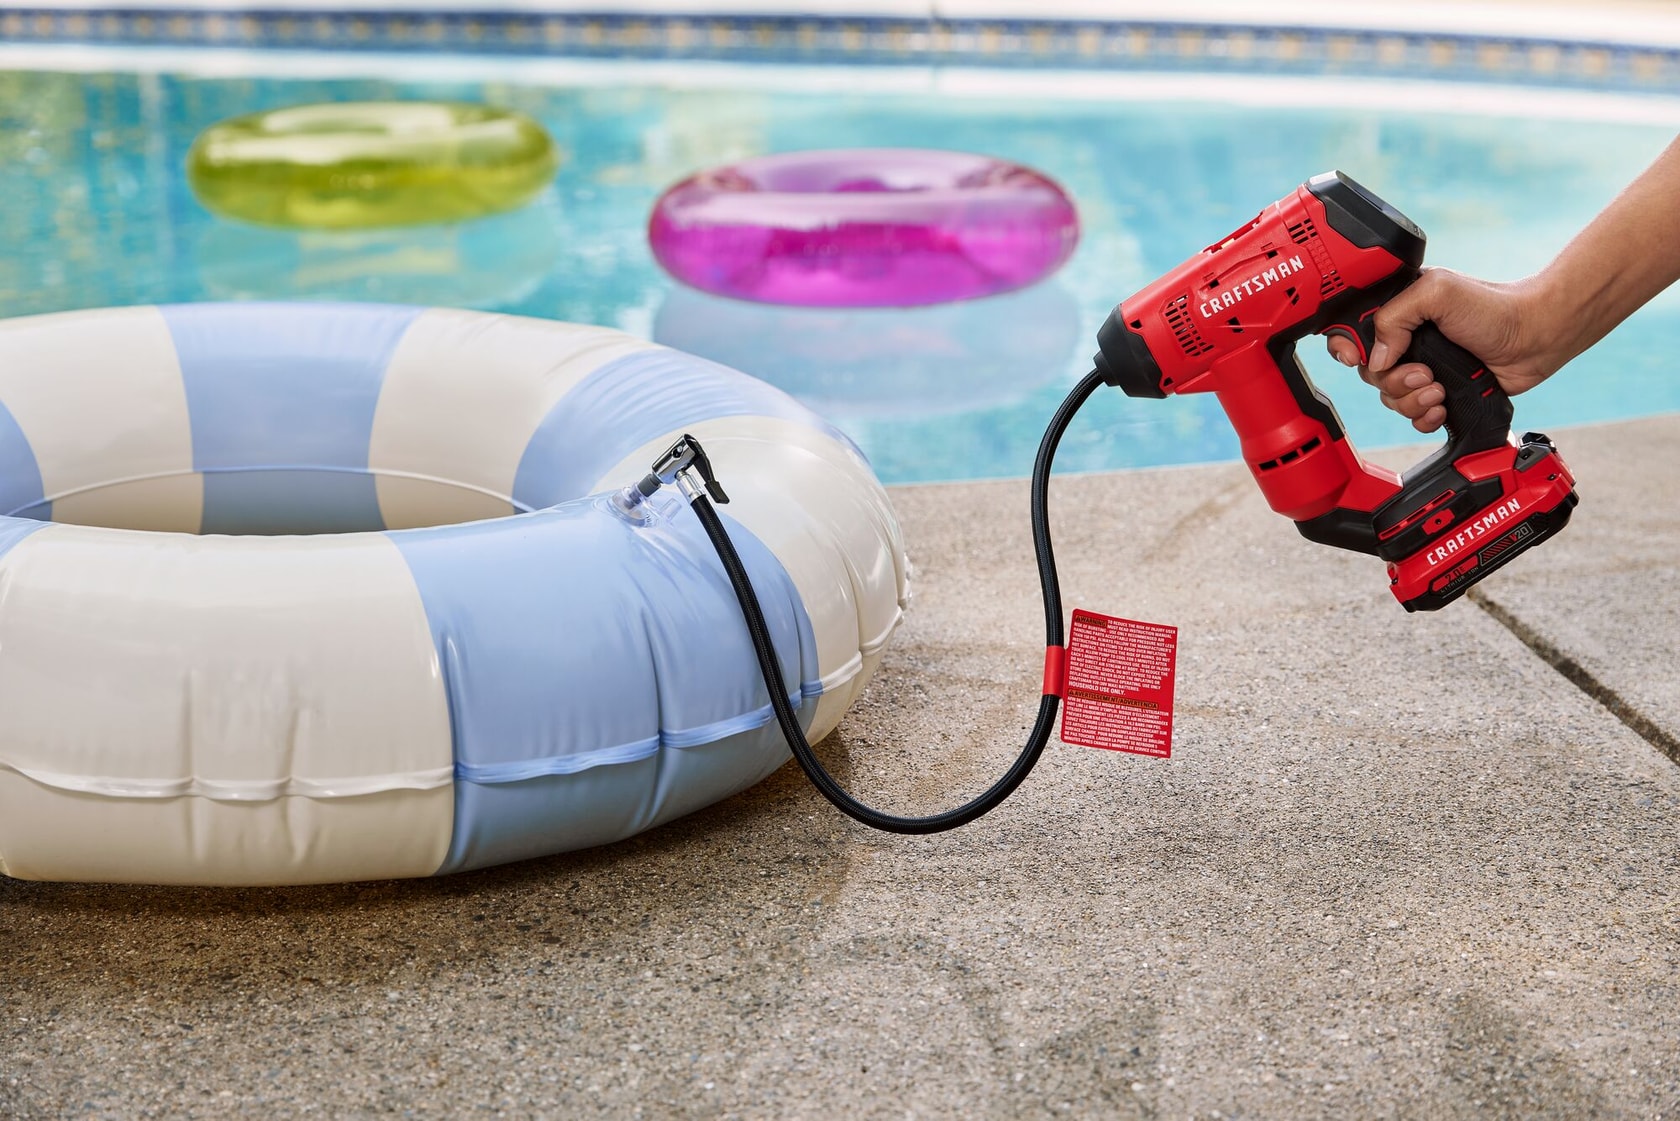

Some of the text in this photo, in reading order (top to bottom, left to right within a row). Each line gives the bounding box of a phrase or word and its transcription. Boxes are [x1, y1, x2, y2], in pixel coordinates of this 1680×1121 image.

[1200, 255, 1304, 318] CRAFTSMAN
[1426, 498, 1521, 565] CRAFTSMAN
[1068, 681, 1098, 691] HOUSEHOLD
